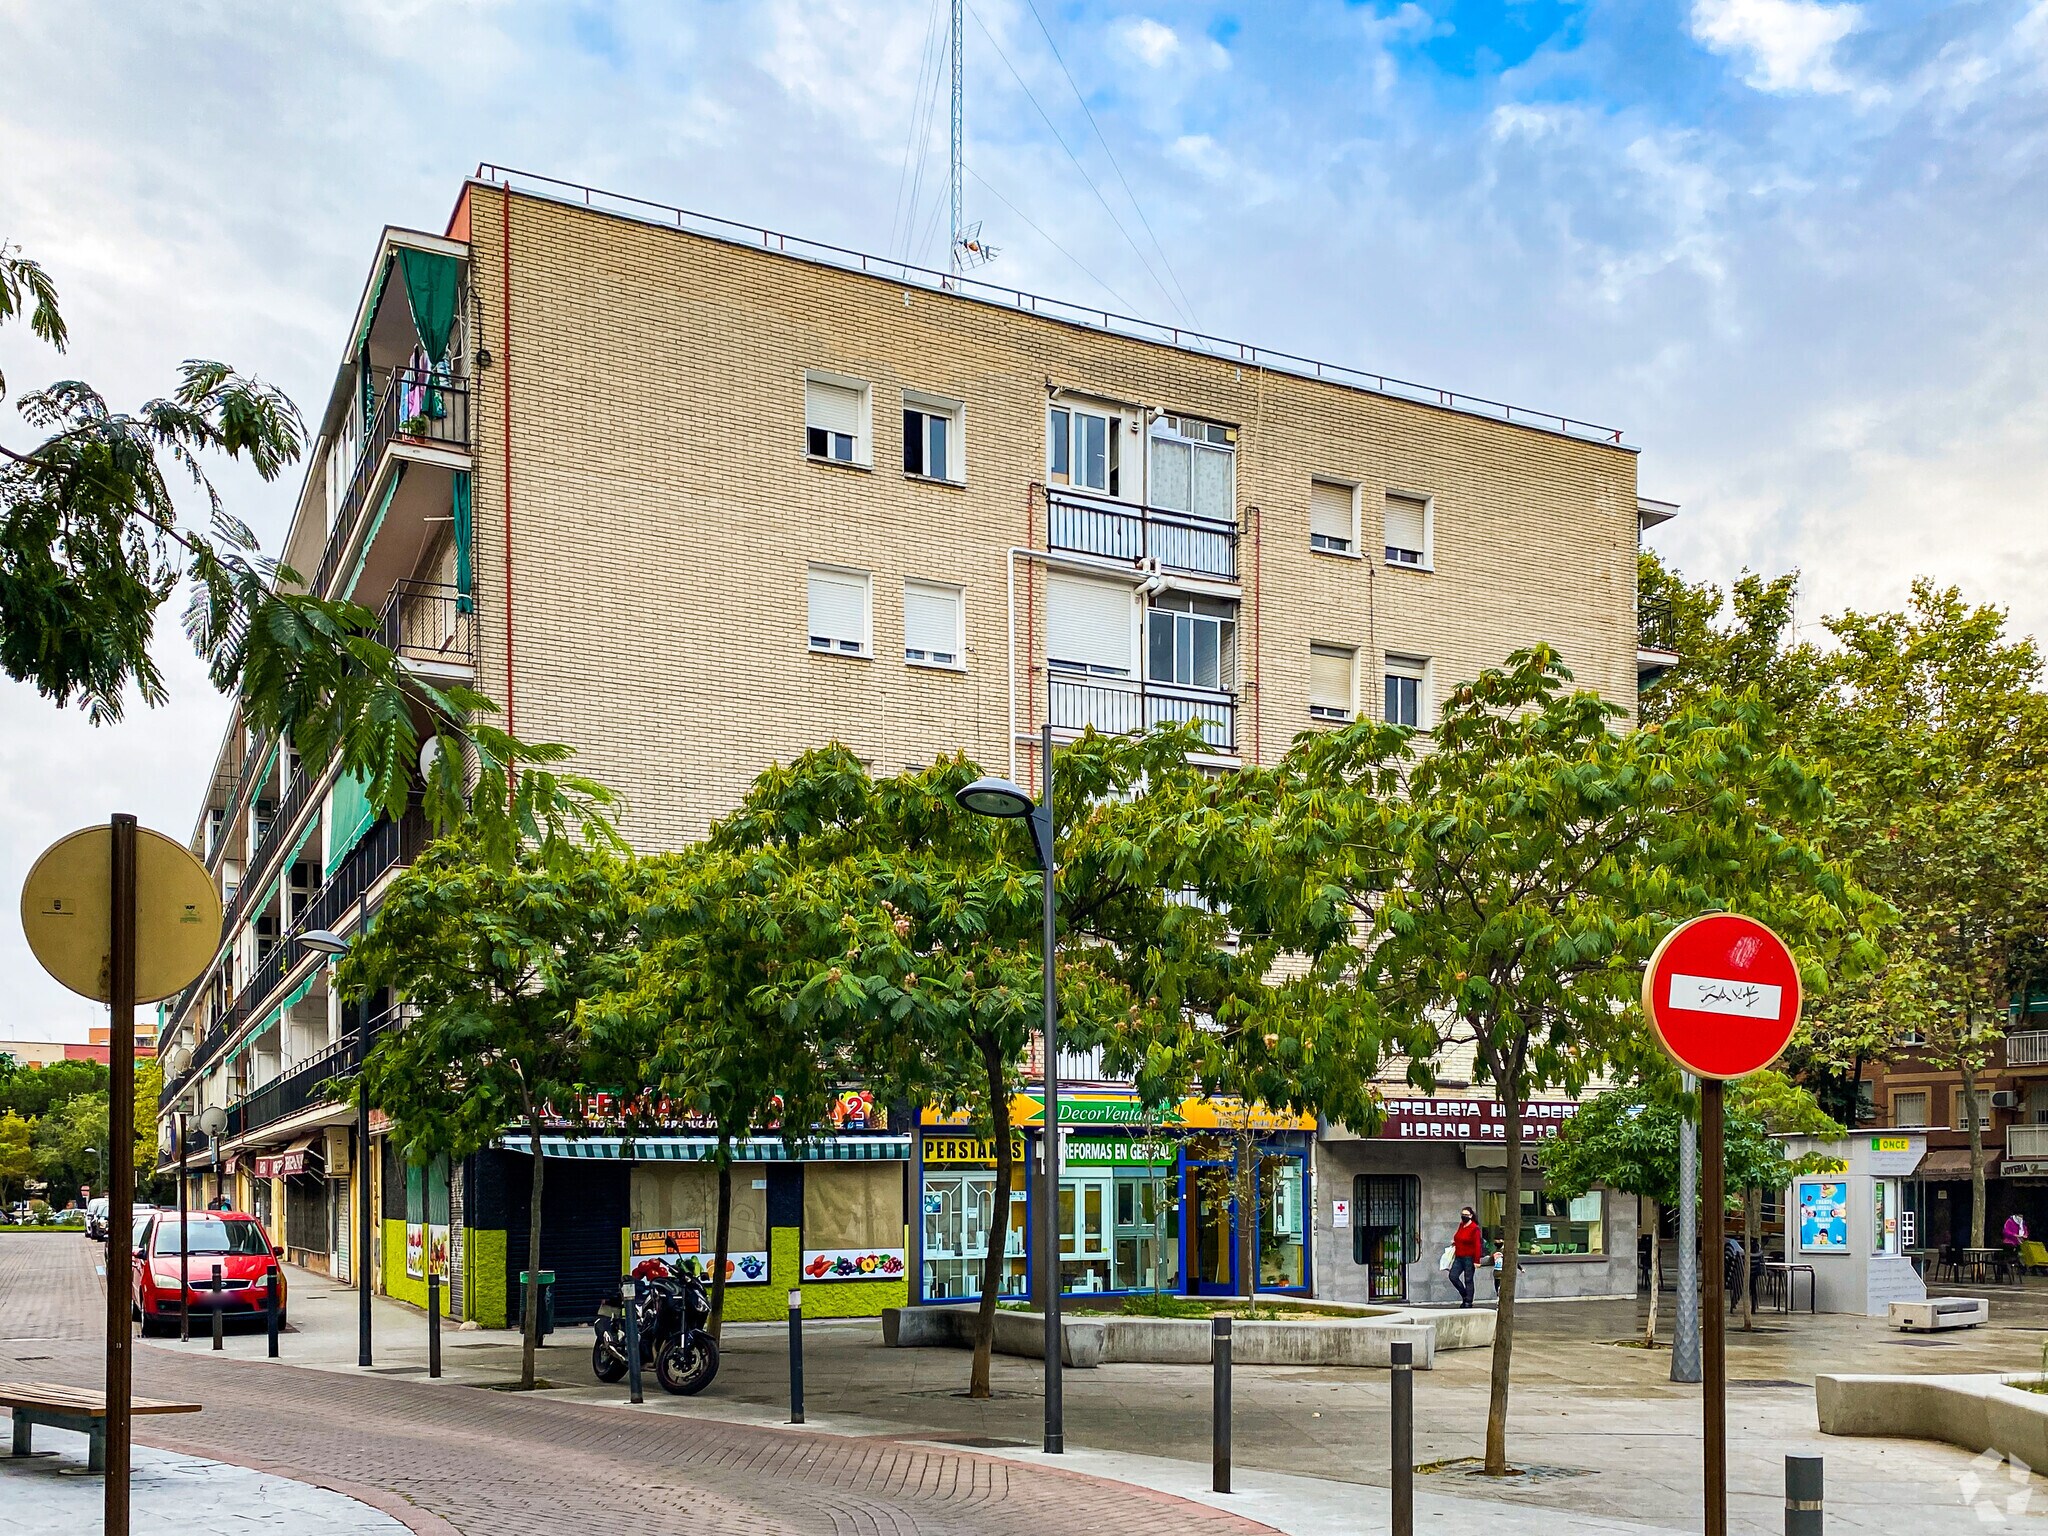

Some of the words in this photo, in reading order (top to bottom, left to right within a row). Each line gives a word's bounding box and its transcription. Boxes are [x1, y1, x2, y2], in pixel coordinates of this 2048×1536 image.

[1400, 1122, 1471, 1137] HORNO
[1480, 1124, 1558, 1138] PRPIO
[925, 1141, 1021, 1159] PERSIANS
[1882, 1140, 1906, 1149] ONCE
[1115, 1143, 1127, 1160] EN
[641, 1231, 665, 1240] ALQUILA
[677, 1230, 699, 1239] VENDE
